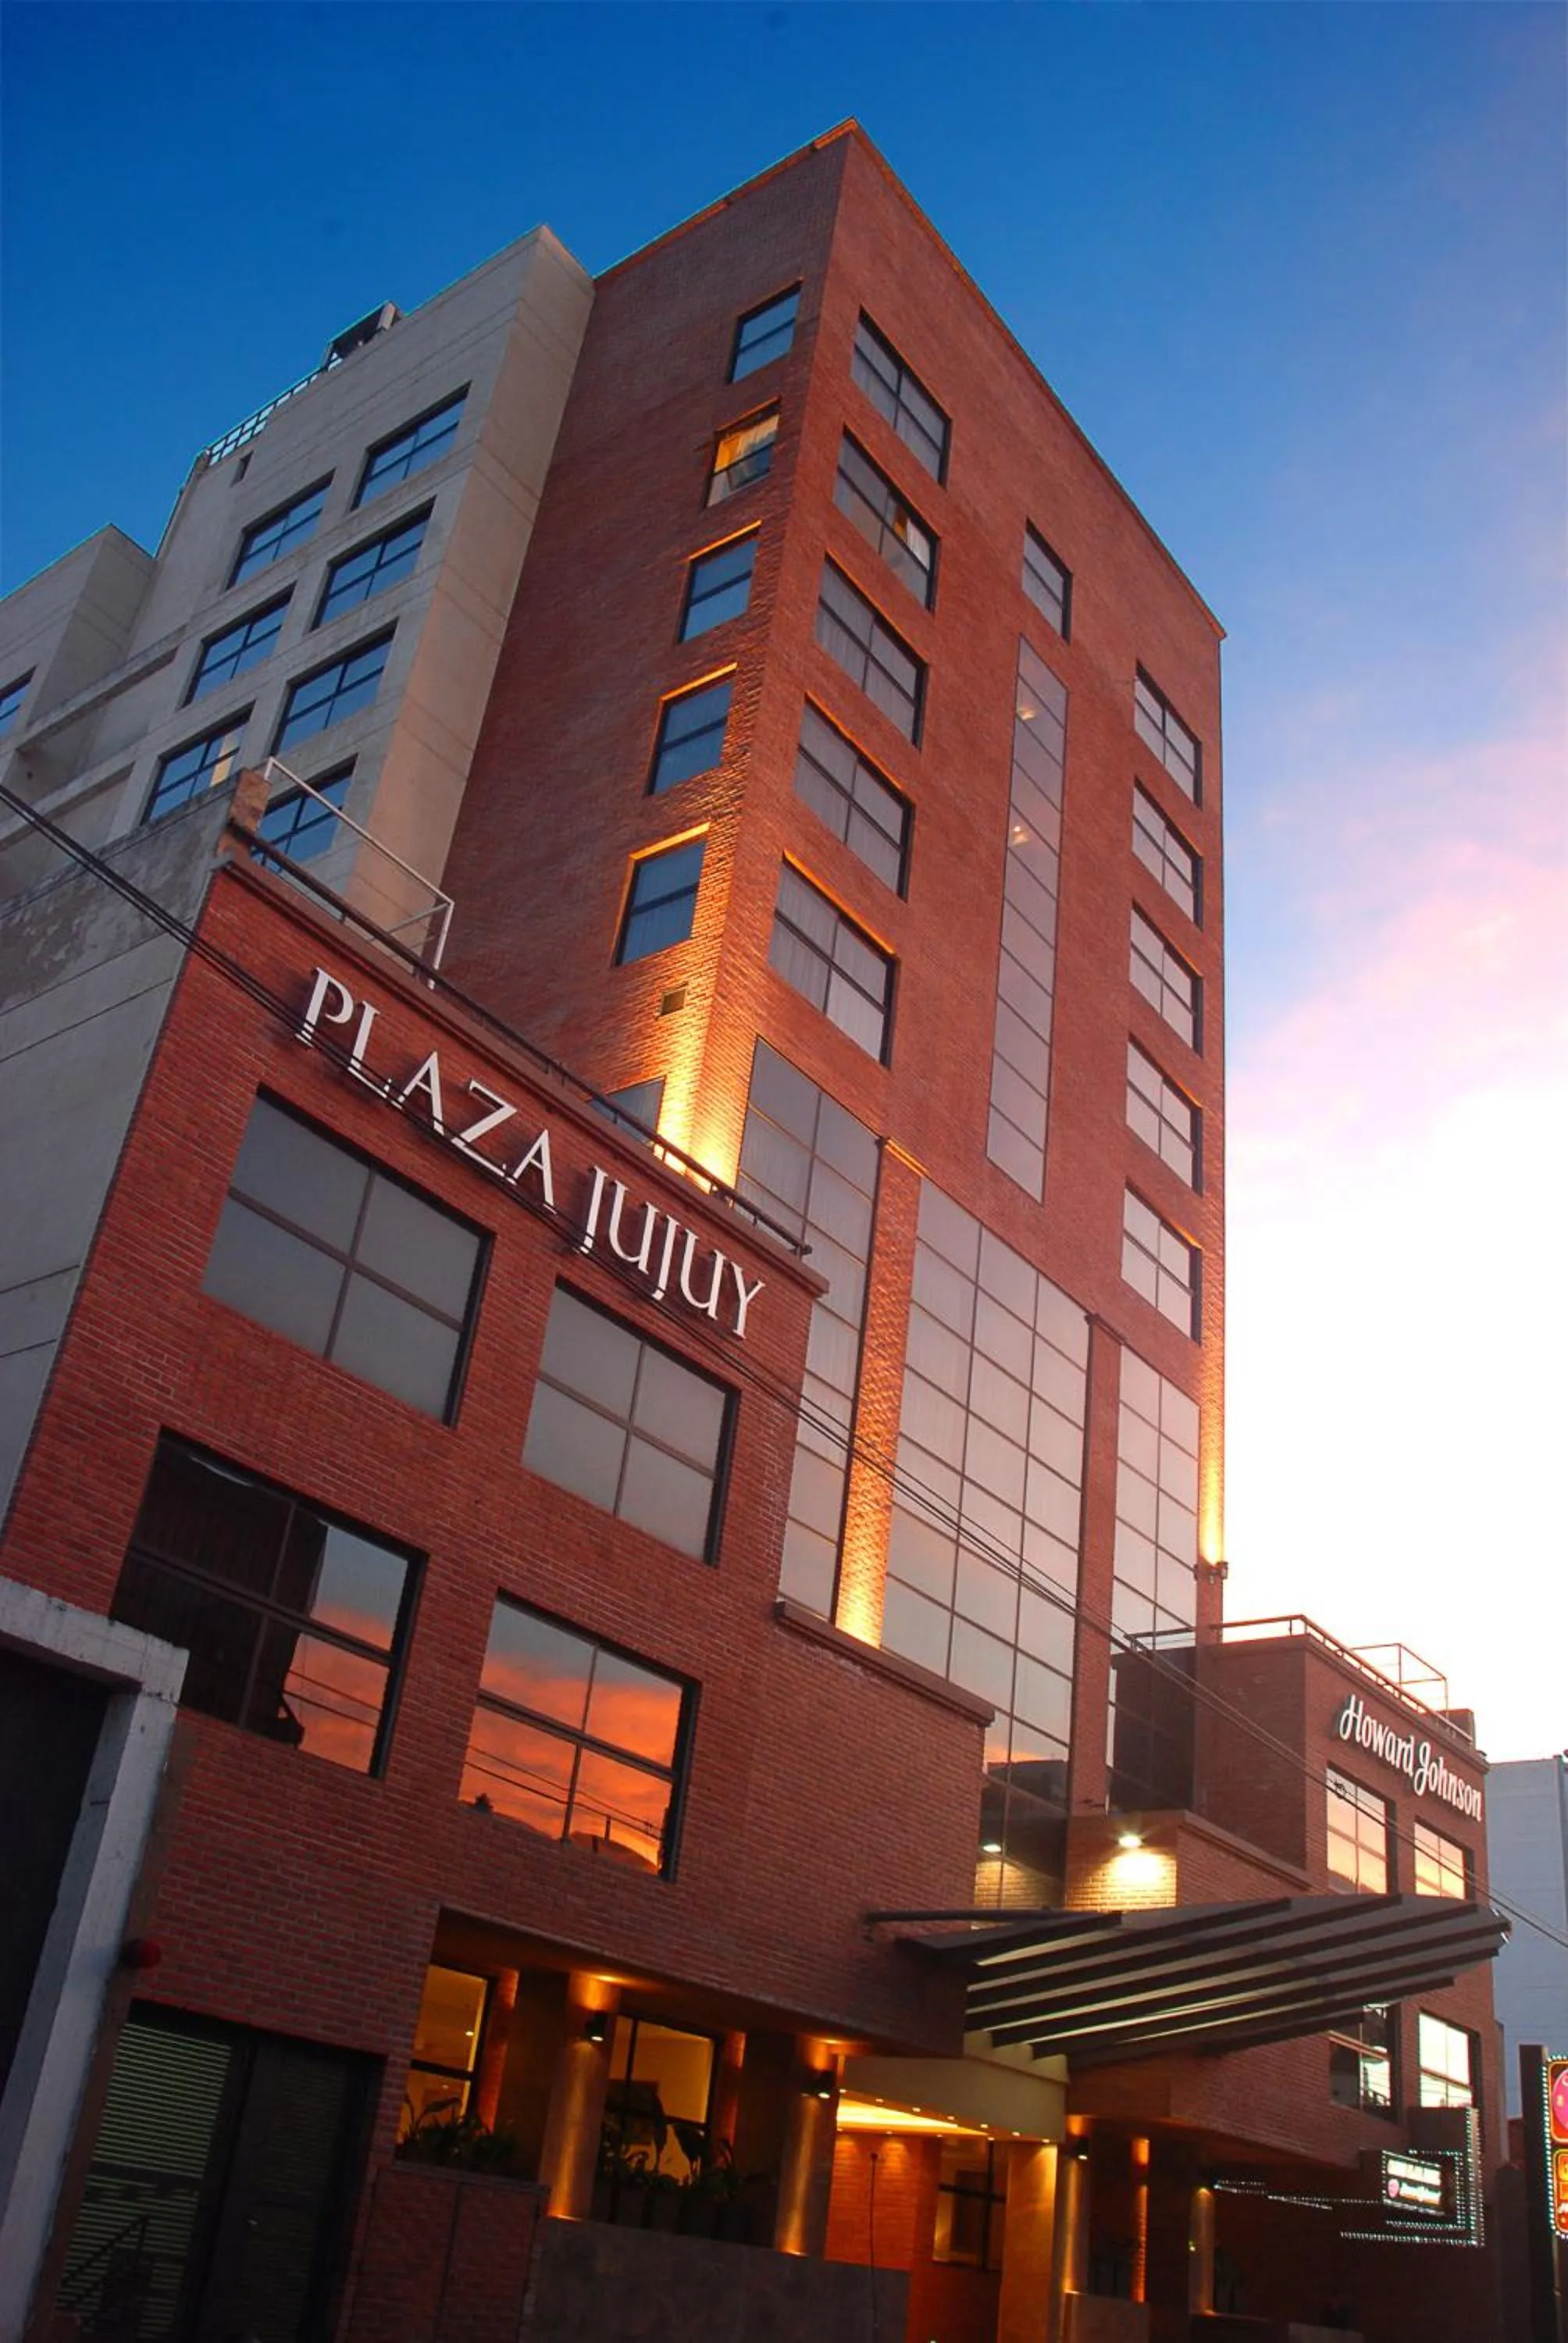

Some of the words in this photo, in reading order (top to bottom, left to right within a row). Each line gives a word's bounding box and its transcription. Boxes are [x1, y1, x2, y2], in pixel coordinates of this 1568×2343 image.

[294, 967, 557, 1214] PLAZA
[576, 1165, 766, 1340] JUJUY
[1339, 1693, 1415, 1778] Howard
[1414, 1742, 1482, 1823] Johnson
